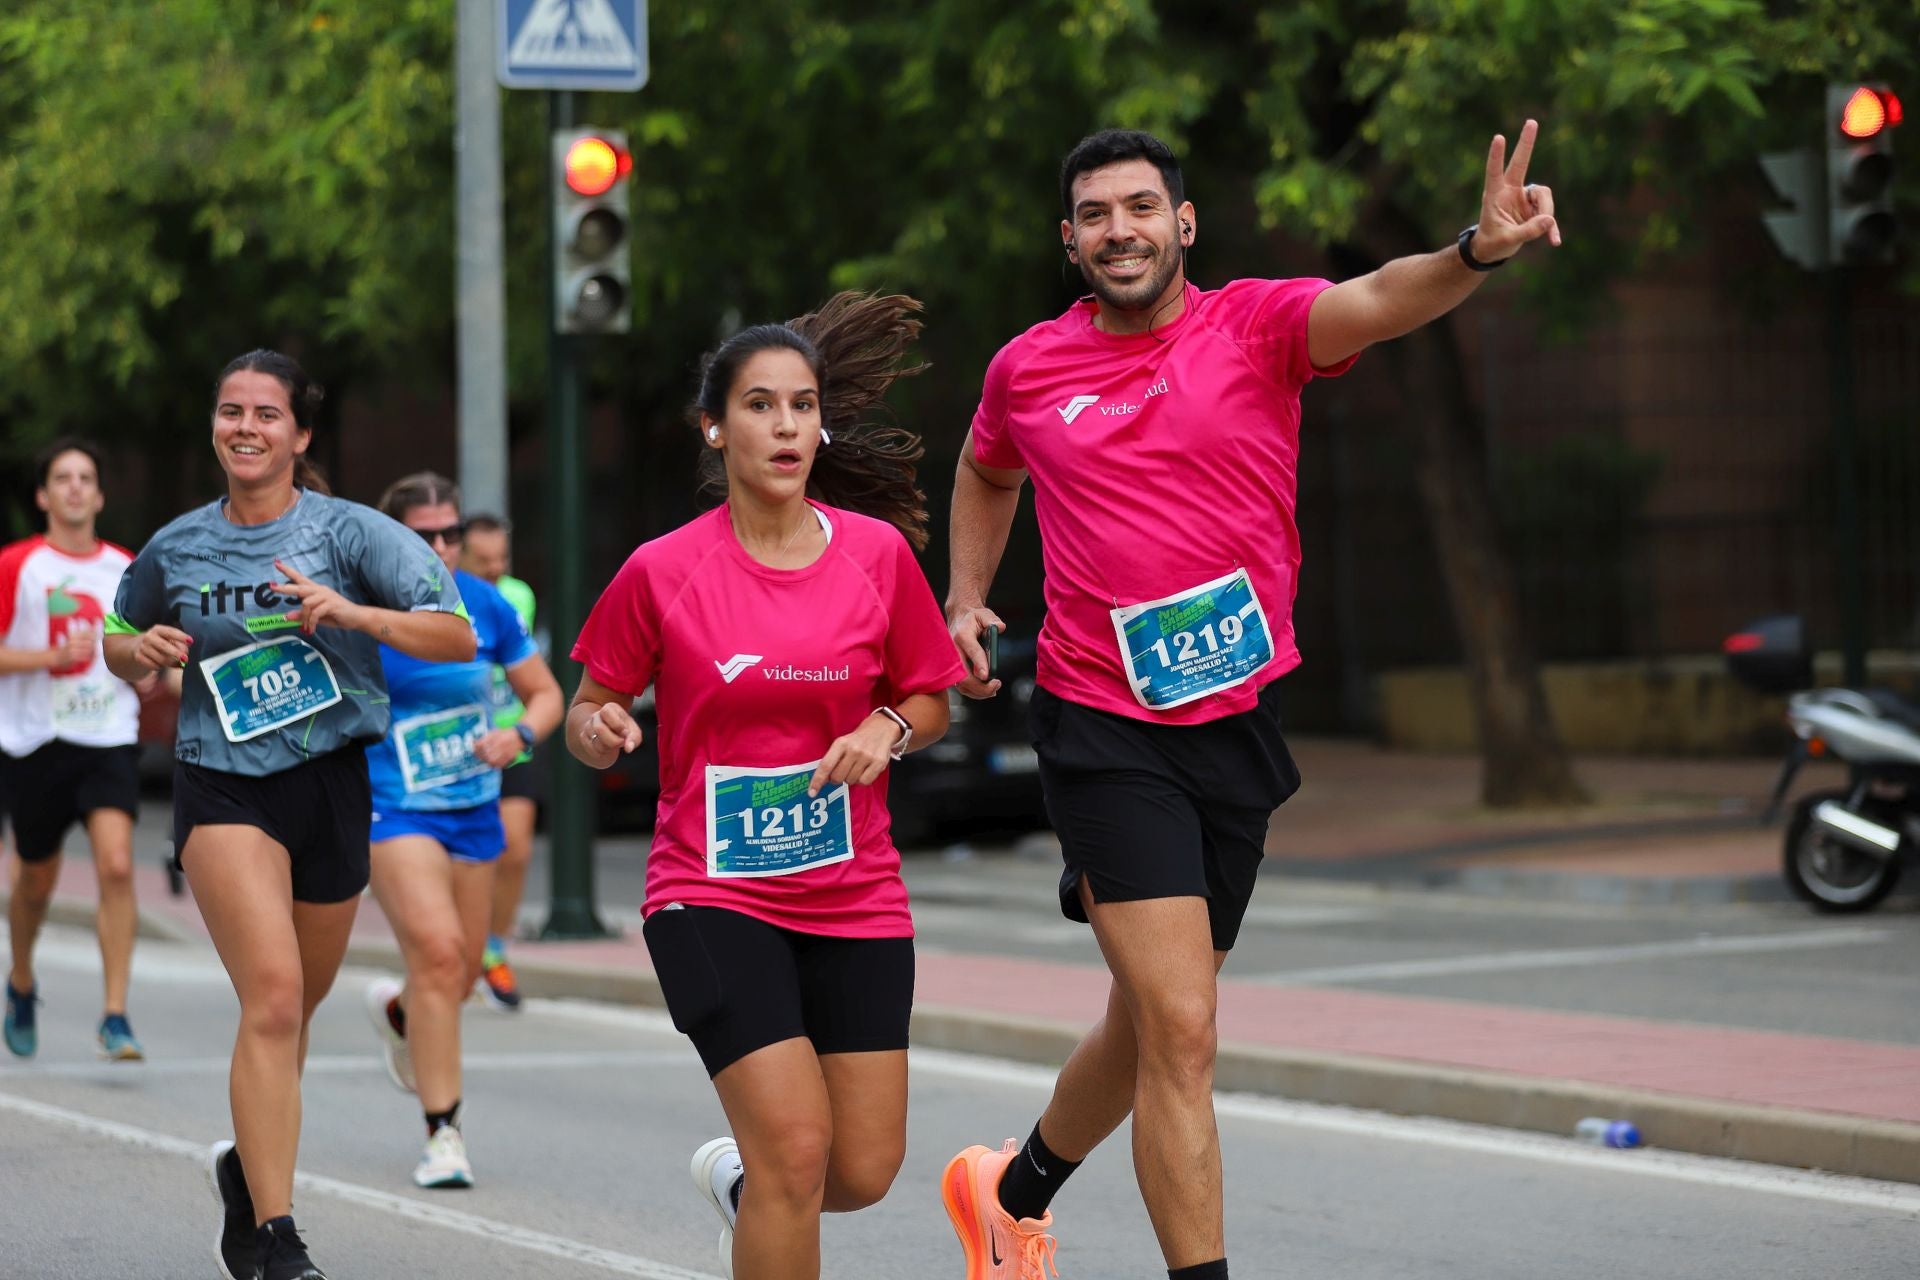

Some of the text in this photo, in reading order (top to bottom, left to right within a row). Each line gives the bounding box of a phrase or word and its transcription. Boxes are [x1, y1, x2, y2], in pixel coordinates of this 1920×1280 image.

[1160, 592, 1214, 630] CARRERA
[1150, 615, 1244, 668] 1219
[763, 664, 849, 682] videsalud
[1170, 659, 1194, 673] JOAQUIN
[1193, 651, 1221, 665] MARTINEZ
[1181, 655, 1228, 677] VIDESALUD 4
[242, 661, 302, 703] 705
[751, 773, 809, 801] CARRERA
[738, 798, 829, 838] 1213
[745, 837, 777, 846] ALMUDENA
[762, 840, 803, 853] VIDESALUD
[803, 838, 810, 847] 2
